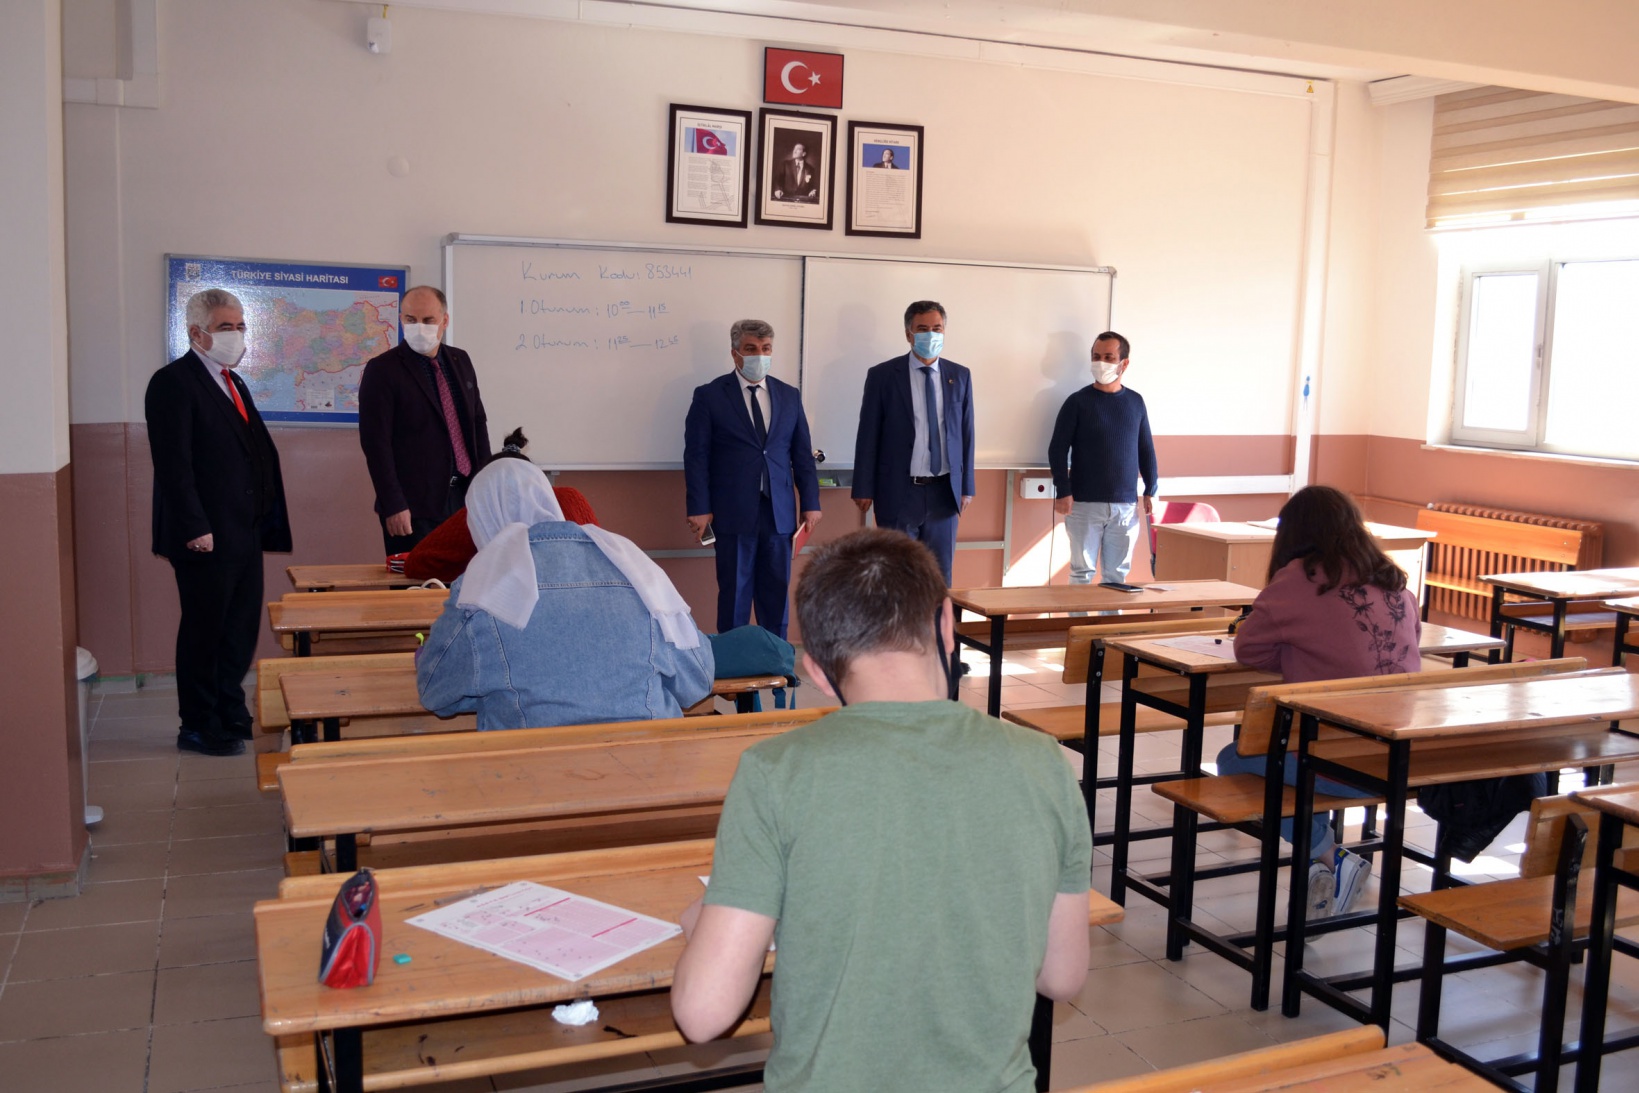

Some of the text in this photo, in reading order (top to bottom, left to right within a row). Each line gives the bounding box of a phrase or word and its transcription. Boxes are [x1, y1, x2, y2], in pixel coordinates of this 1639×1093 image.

[231, 270, 349, 284] TÜRKİYE SİYASİ HARİTASI
[521, 260, 581, 281] Kurum
[645, 263, 692, 280] 853441
